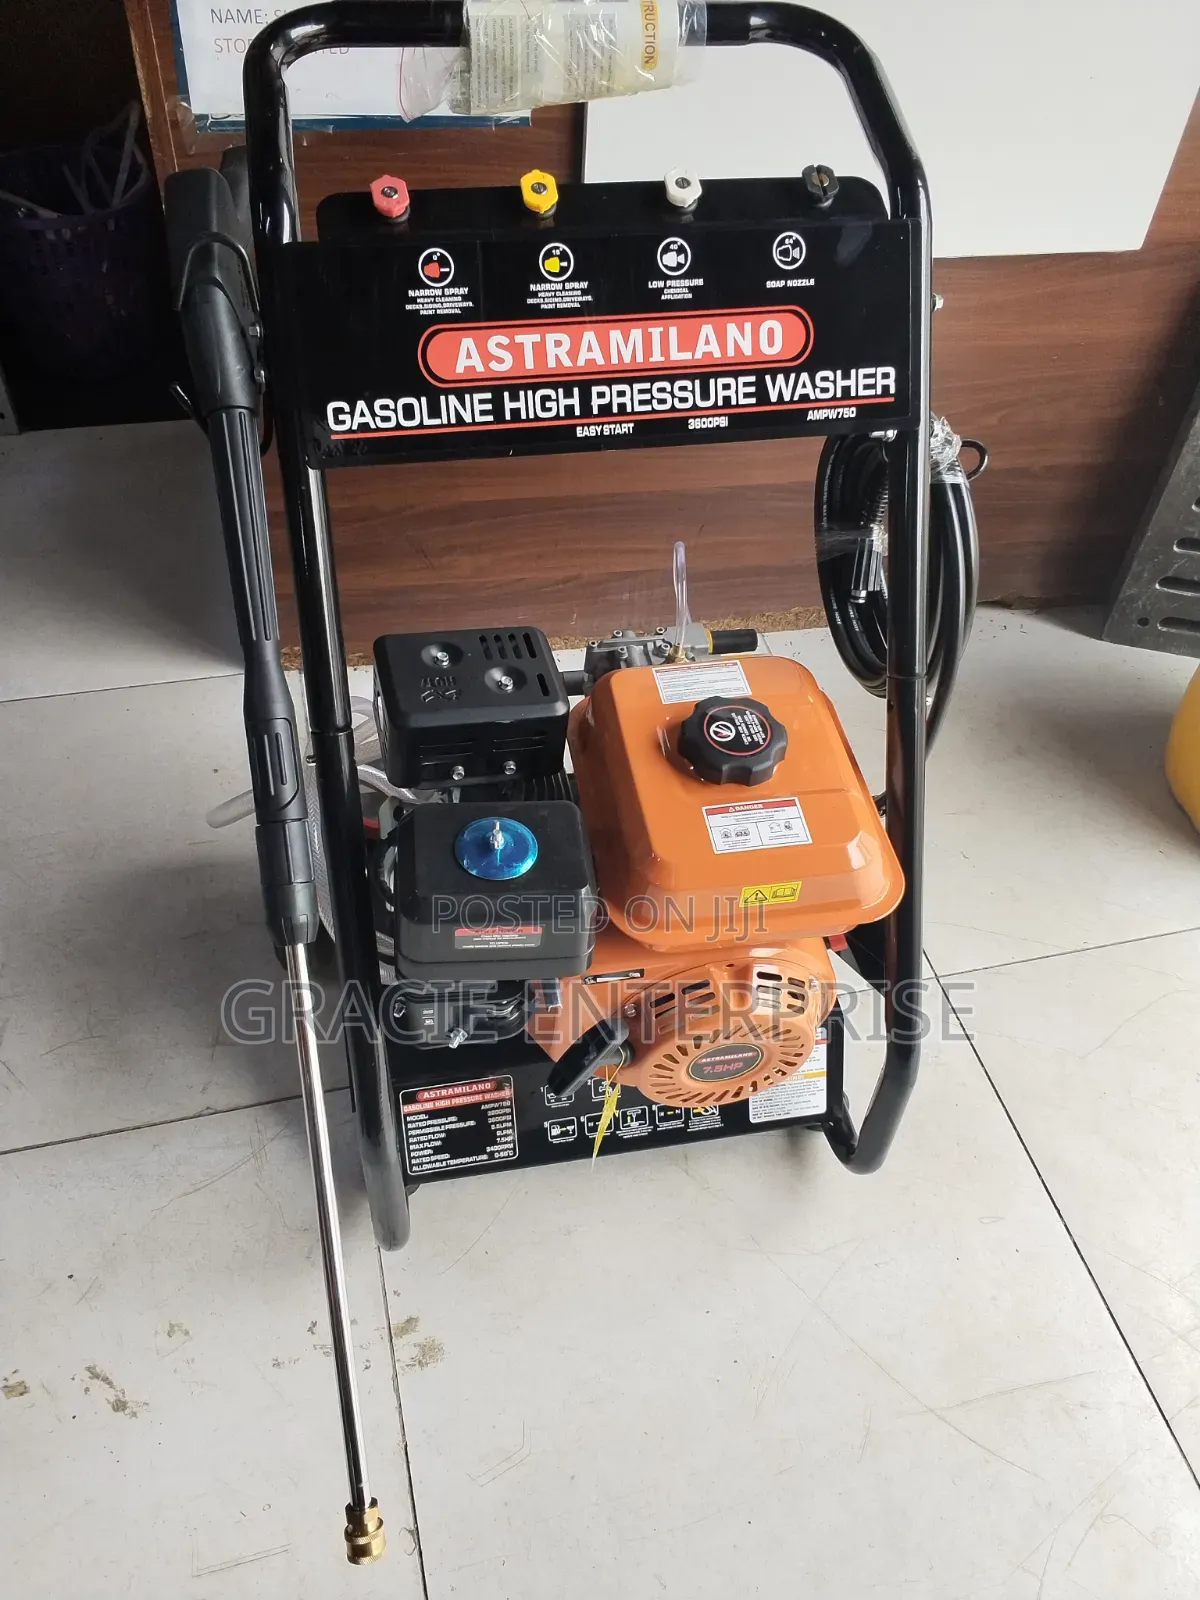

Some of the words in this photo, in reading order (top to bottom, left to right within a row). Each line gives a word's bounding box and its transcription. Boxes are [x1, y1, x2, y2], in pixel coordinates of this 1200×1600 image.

[210, 8, 269, 25] NAME:
[530, 282, 563, 292] NARROW
[564, 281, 589, 291] SPRAY
[648, 281, 665, 289] LOW
[666, 278, 704, 288] PRESSURE
[766, 280, 786, 288] SOAP
[786, 279, 815, 287] NOZZLE
[408, 289, 443, 298] NARROW
[444, 287, 469, 296] SPRAY
[455, 320, 784, 374] ASTRAMILANO
[326, 393, 495, 432] GASOLINE
[503, 387, 581, 421] HIGH
[591, 375, 757, 415] PRESSURE
[764, 366, 897, 402] WASHER
[807, 407, 857, 421] AMPW750
[688, 416, 729, 430] 3600PSI
[576, 425, 603, 438] EASY
[603, 423, 635, 436] START
[703, 1062, 744, 1074] 7.5HP
[423, 1082, 491, 1099] ASTRAMILANO
[403, 1101, 434, 1113] GASOLINE
[435, 1099, 451, 1108] HIGH
[451, 1094, 483, 1106] PRESSURE
